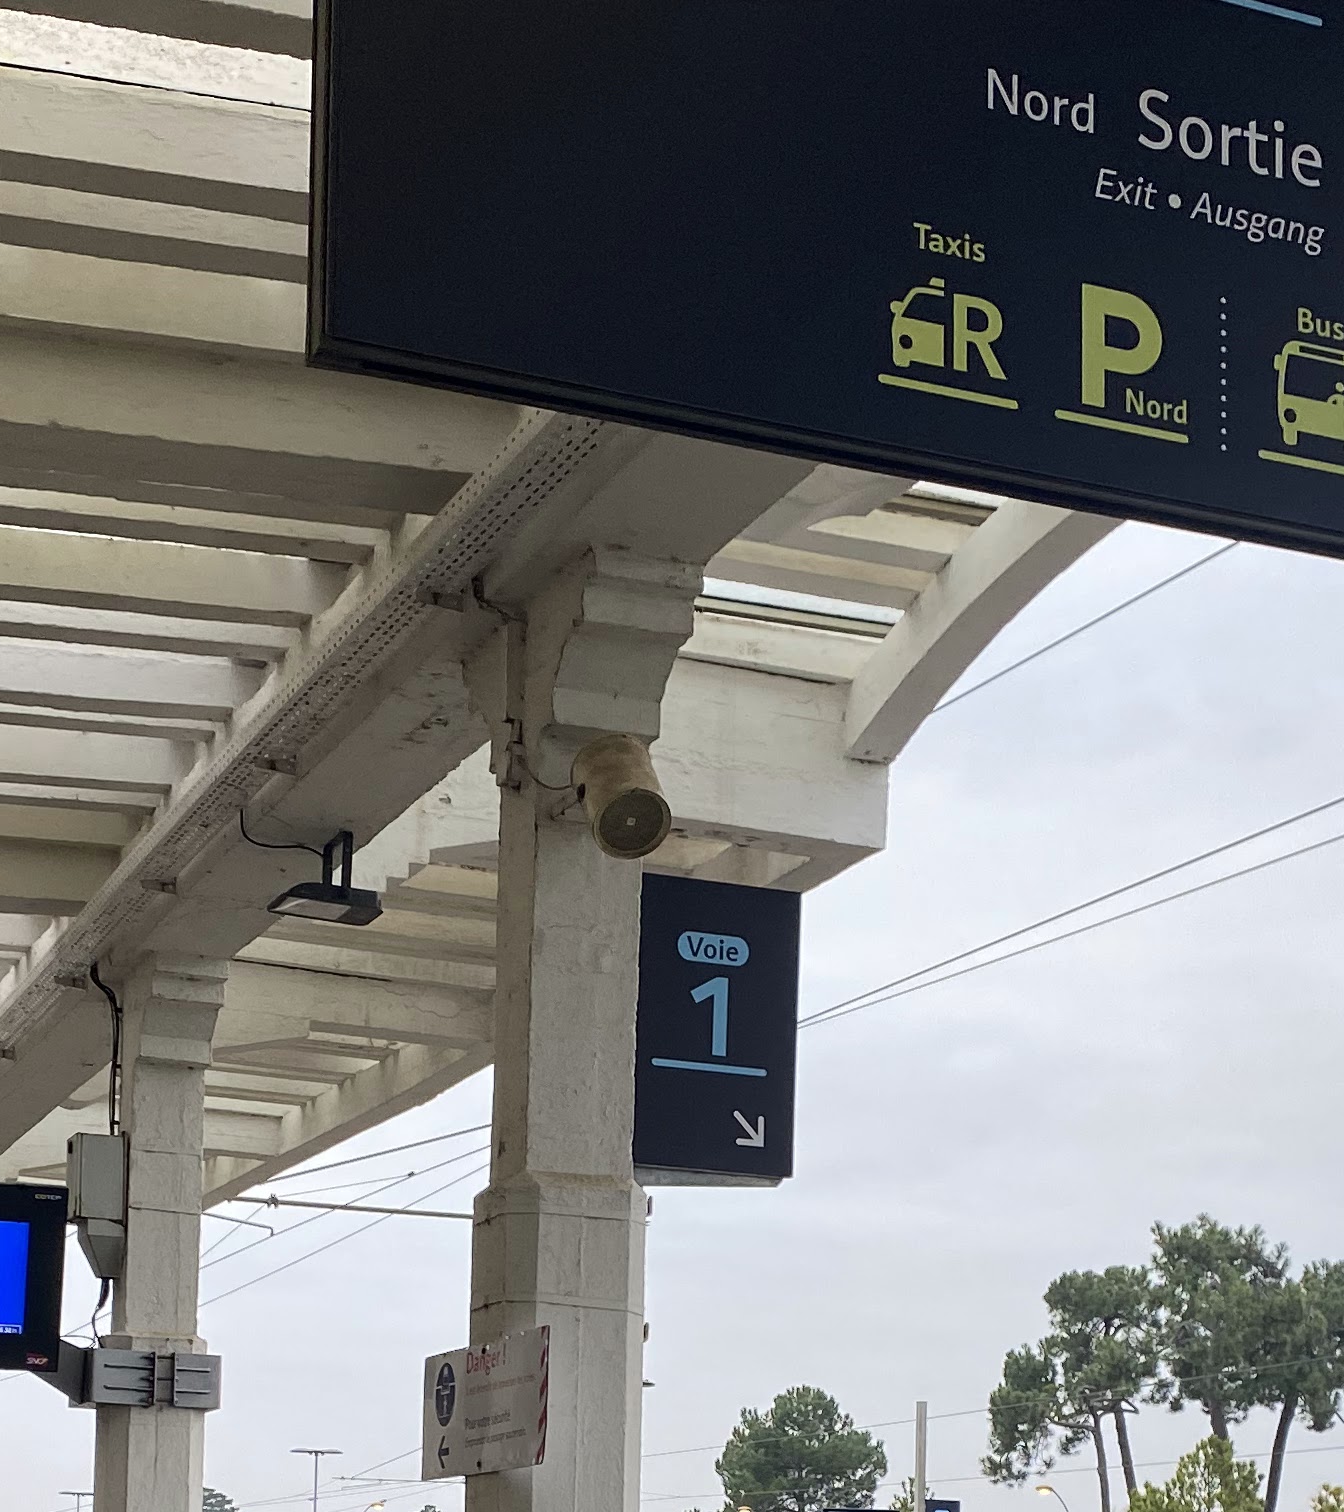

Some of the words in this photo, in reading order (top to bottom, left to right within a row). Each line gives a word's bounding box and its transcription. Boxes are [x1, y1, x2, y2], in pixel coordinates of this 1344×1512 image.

[986, 67, 1095, 134] Nord
[1137, 88, 1323, 188] Sortie
[912, 221, 986, 263] Taxis
[1094, 167, 1158, 210] Exit
[1189, 192, 1325, 256] Ausgang
[1081, 282, 1163, 409] P
[1124, 386, 1188, 425] Nord
[686, 934, 739, 963] Voie
[689, 976, 730, 1058] 1
[466, 1350, 501, 1376] Danger
